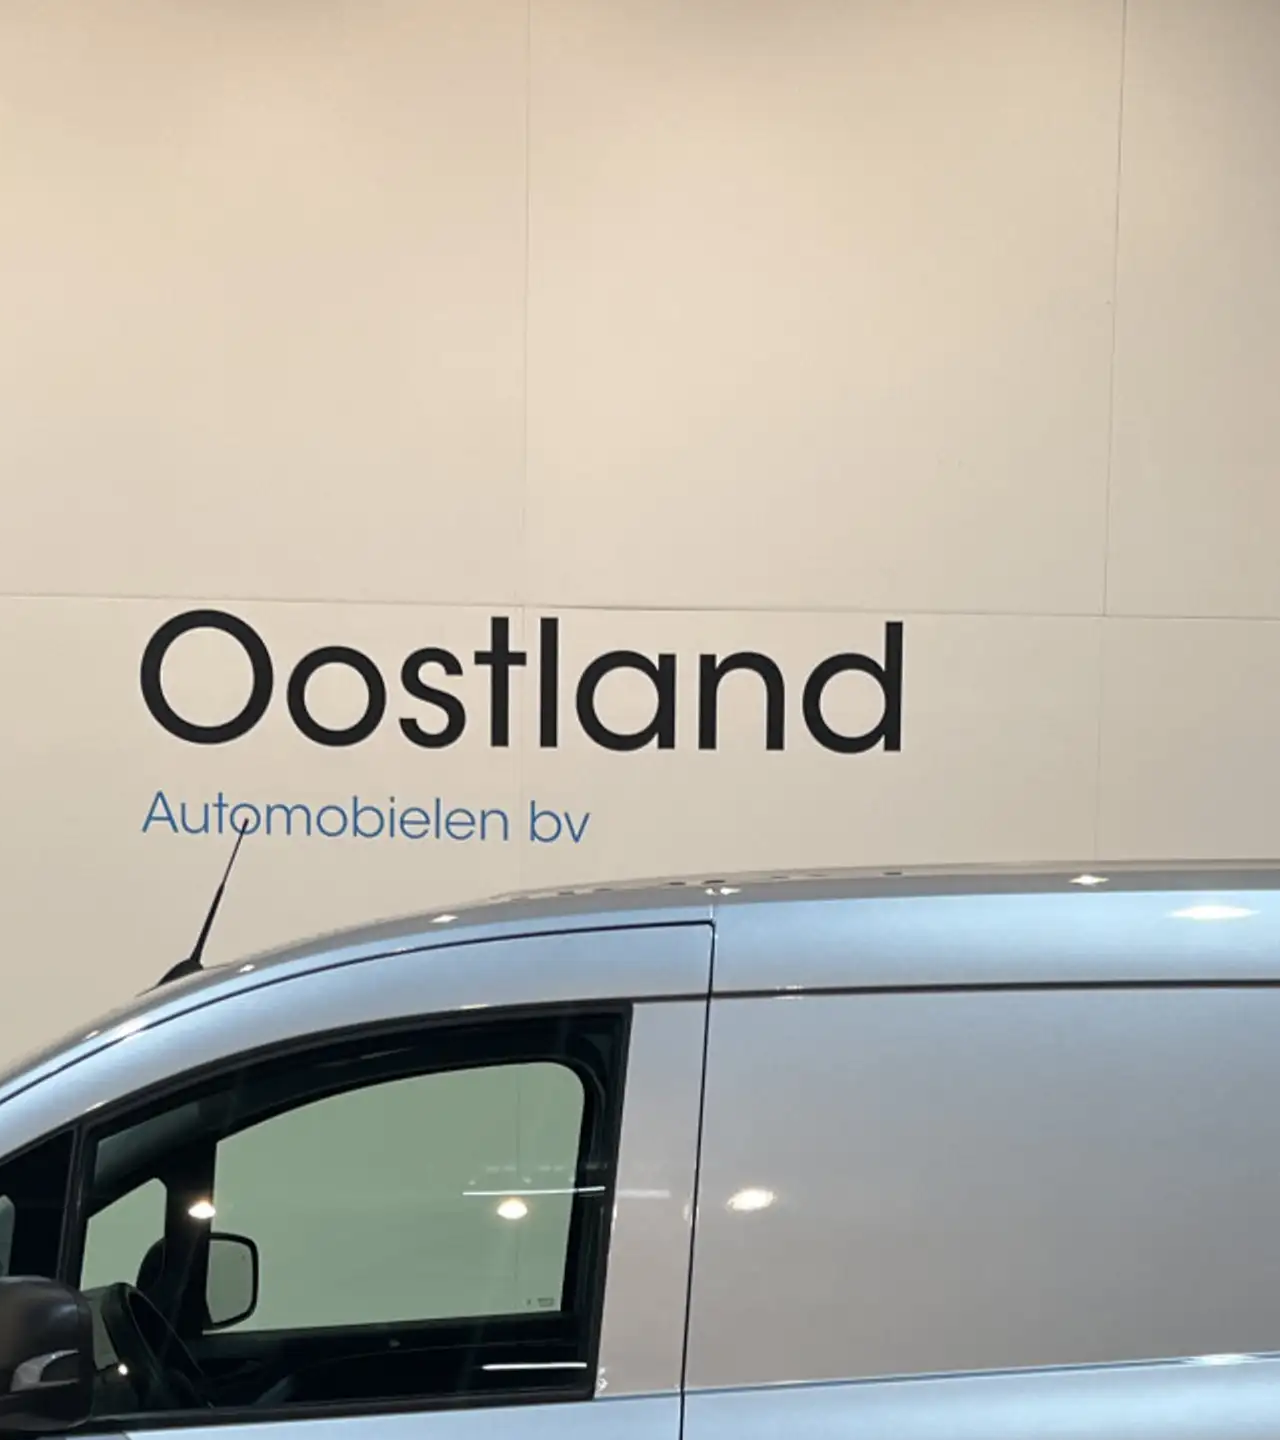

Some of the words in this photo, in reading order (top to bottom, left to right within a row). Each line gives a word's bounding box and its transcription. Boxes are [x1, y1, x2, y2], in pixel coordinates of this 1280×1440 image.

[140, 609, 904, 754] Oostland
[141, 790, 510, 842] Automobielen
[529, 800, 591, 844] bv
